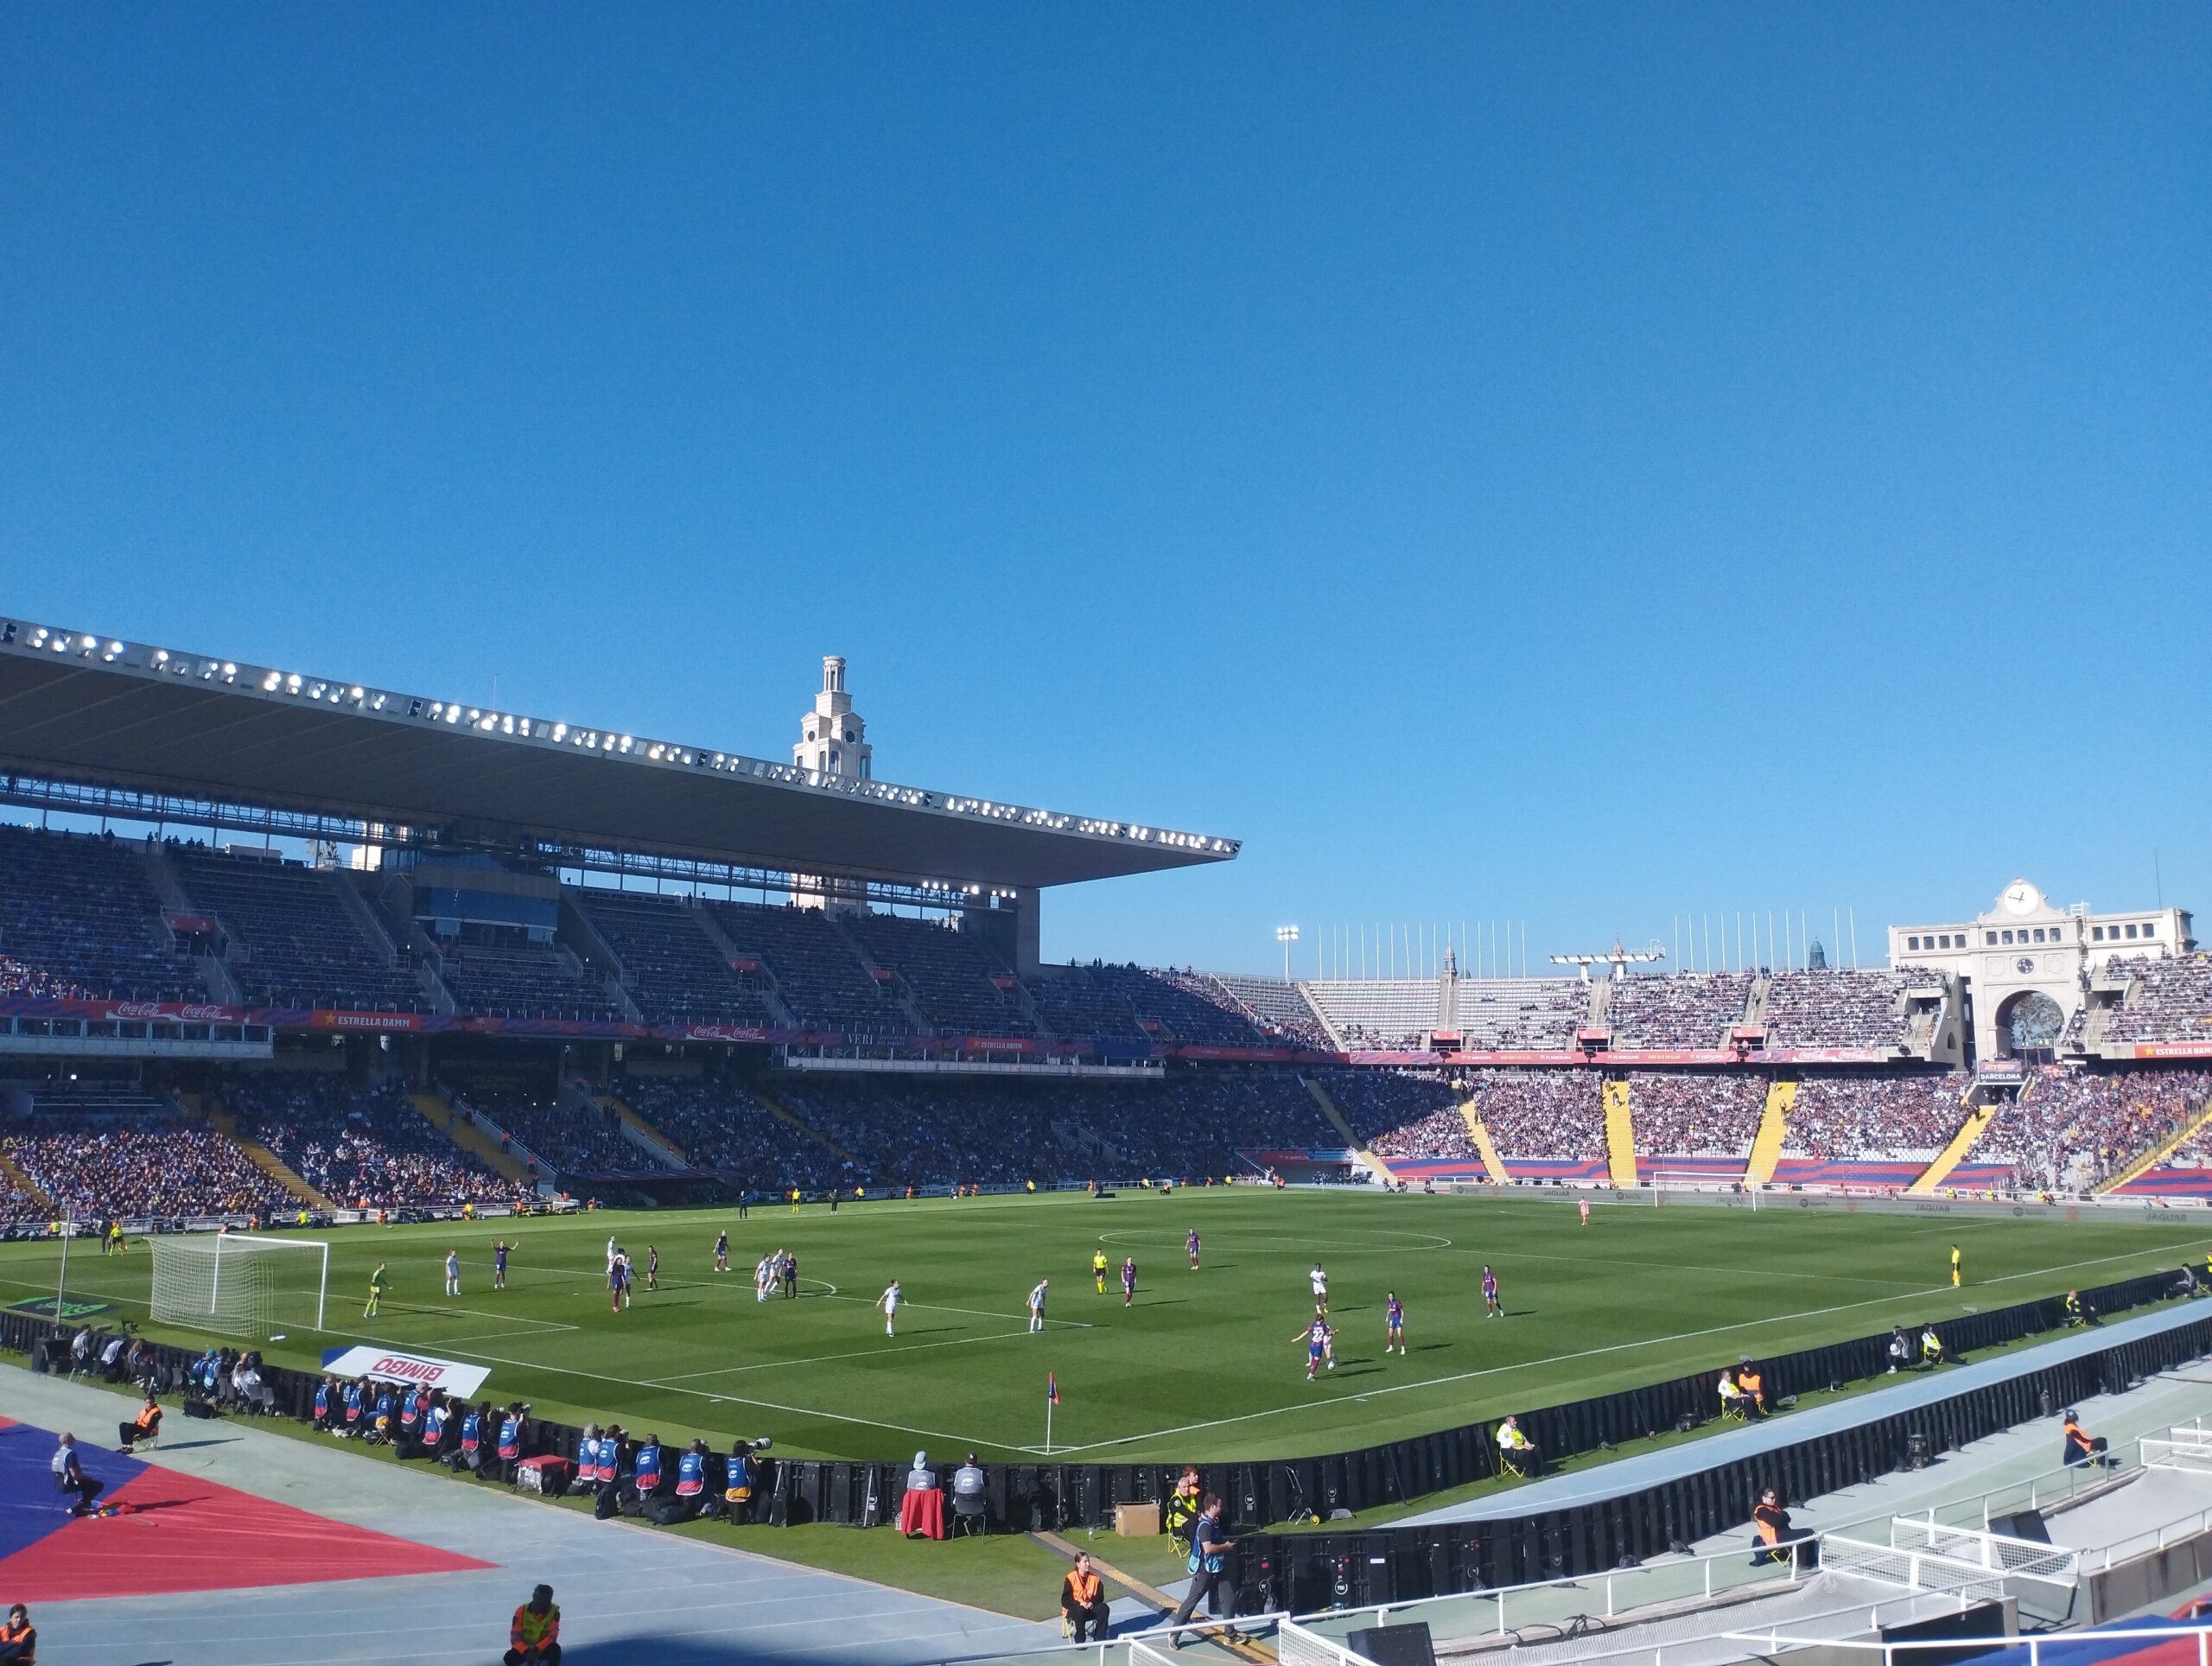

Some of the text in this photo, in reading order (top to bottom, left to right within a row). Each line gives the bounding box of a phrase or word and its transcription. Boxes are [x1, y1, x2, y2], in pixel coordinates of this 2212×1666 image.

[338, 1016, 410, 1027] ESTRELLA DAMM
[848, 1033, 874, 1045] VERI
[2155, 1047, 2193, 1056] ESTRELLA
[1915, 1204, 1950, 1212] JAGUAR
[2145, 1212, 2187, 1222] JAGUAR
[1312, 1330, 1325, 1343] 22
[372, 1358, 445, 1382] BIMBO
